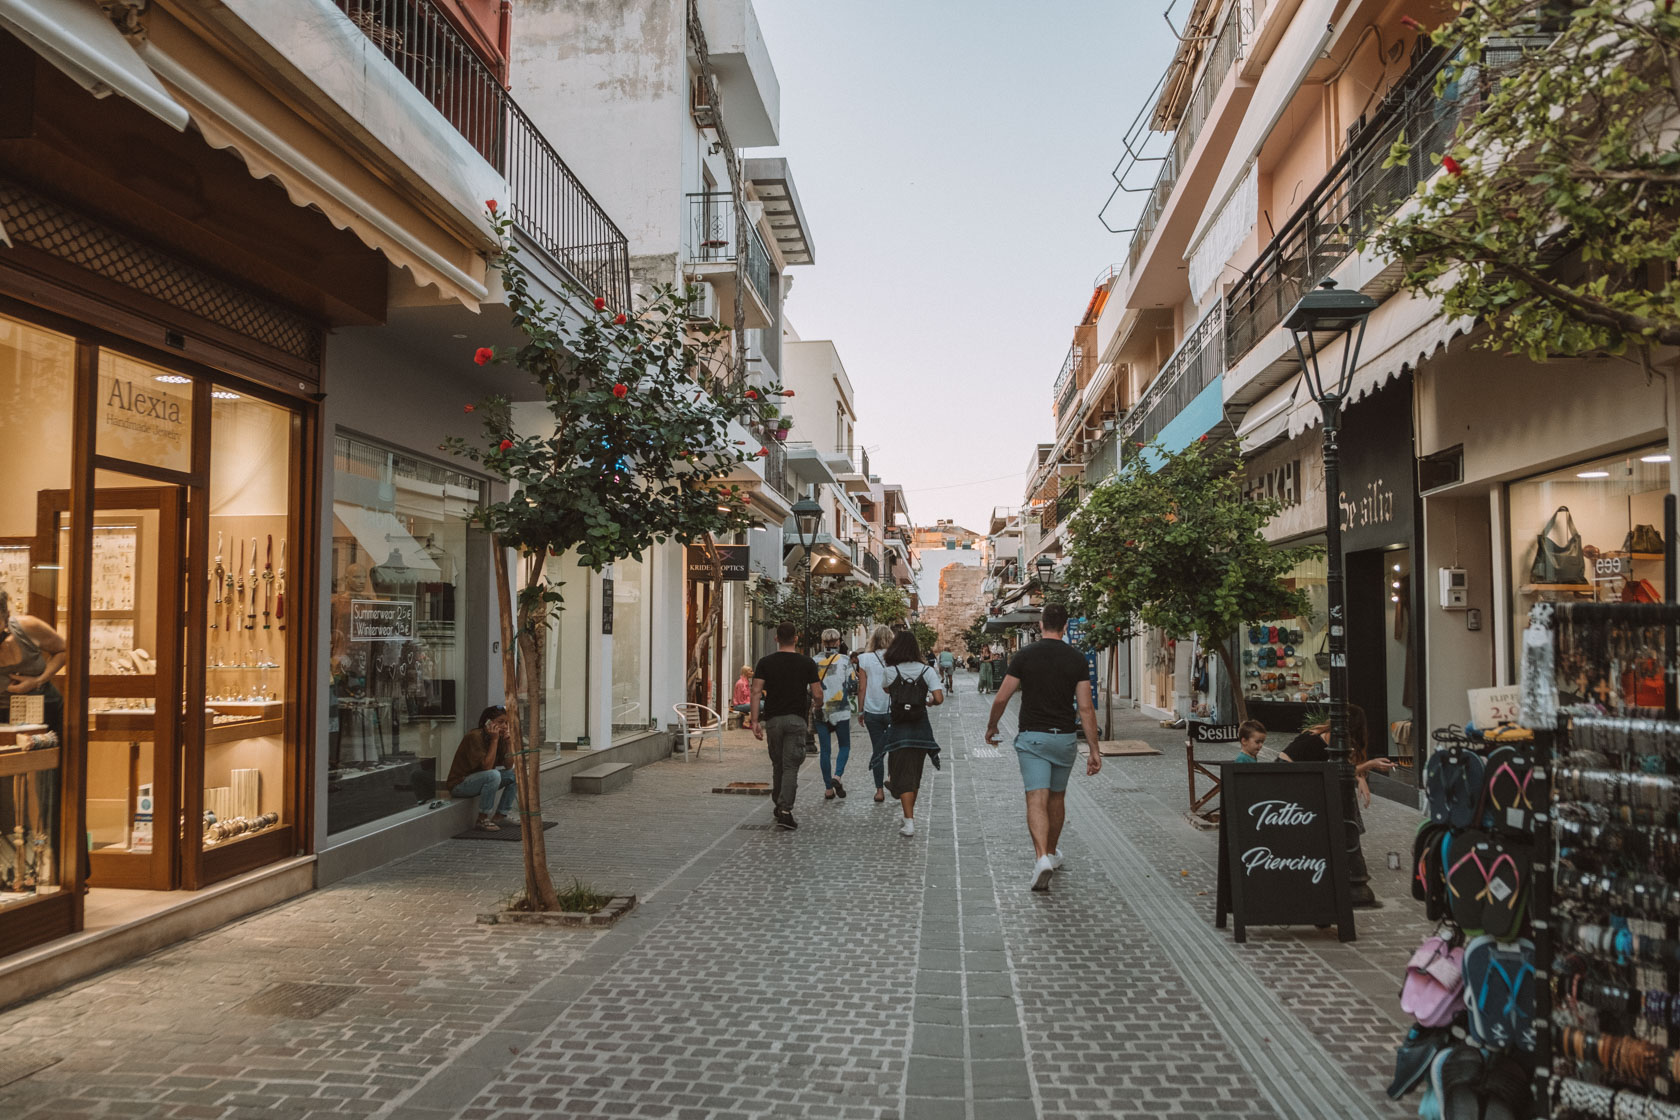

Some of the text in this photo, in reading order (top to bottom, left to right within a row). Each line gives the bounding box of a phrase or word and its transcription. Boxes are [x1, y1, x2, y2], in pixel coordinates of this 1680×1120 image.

[107, 378, 182, 424] Alexia
[721, 564, 744, 572] OPTICS
[354, 604, 412, 620] Summerwear 25€
[357, 621, 394, 636] Winterwear
[1198, 724, 1240, 740] Sesili
[1247, 799, 1317, 831] Tattoo
[1241, 846, 1327, 885] Piercing
